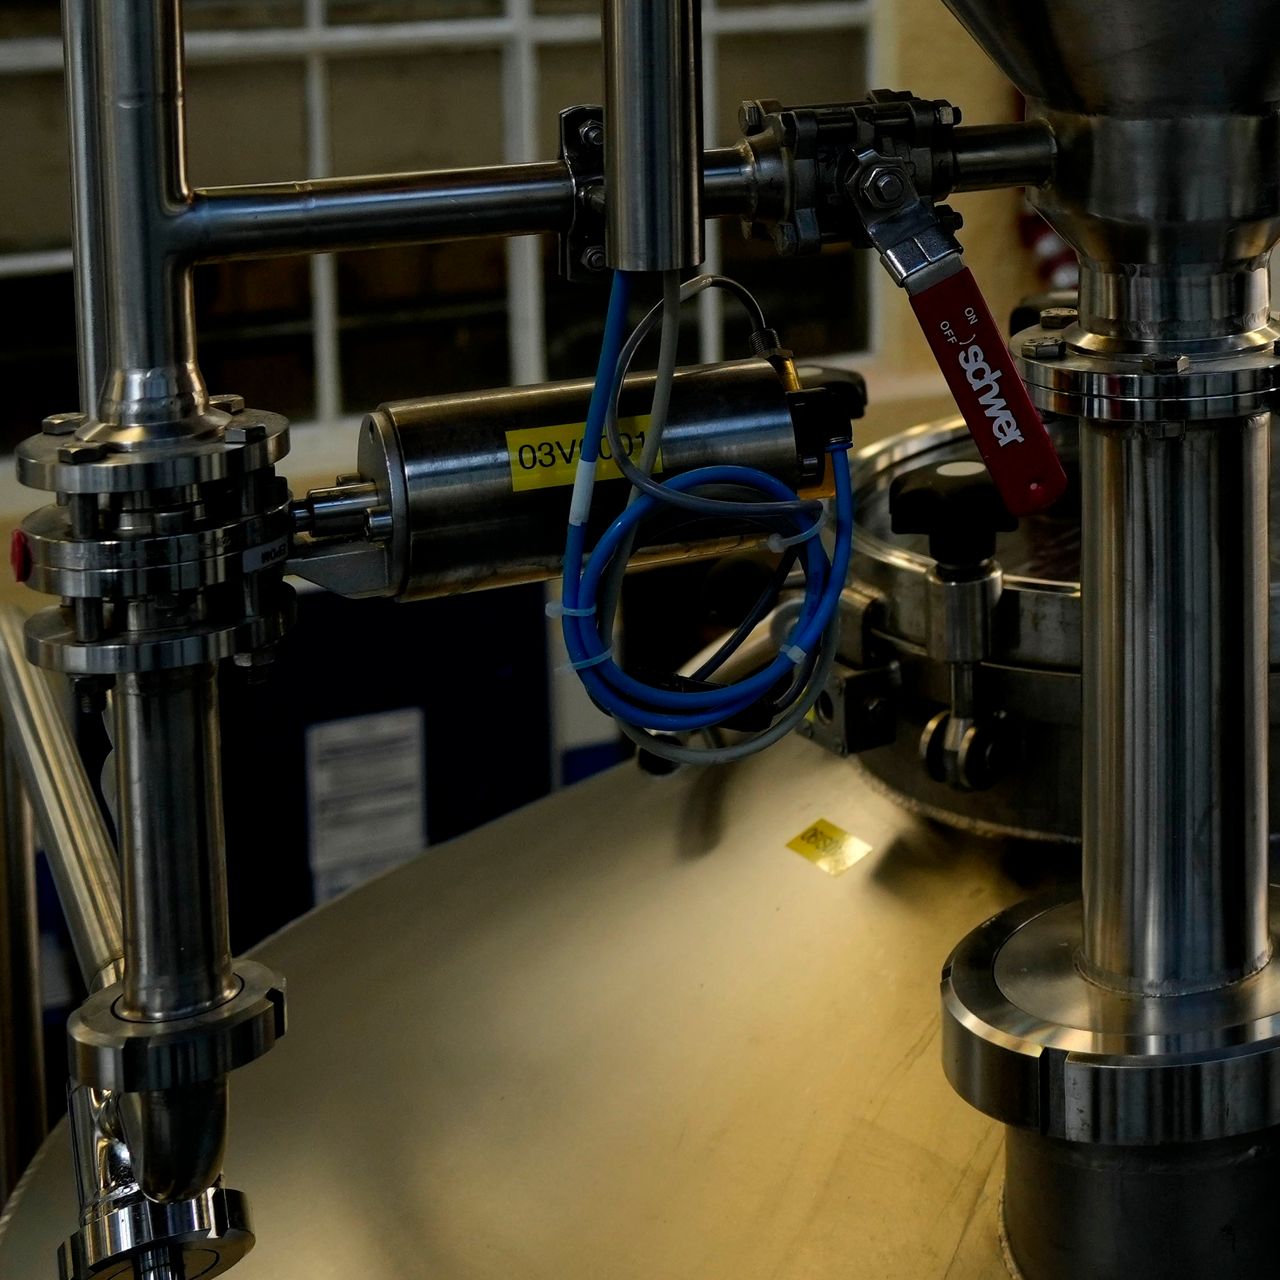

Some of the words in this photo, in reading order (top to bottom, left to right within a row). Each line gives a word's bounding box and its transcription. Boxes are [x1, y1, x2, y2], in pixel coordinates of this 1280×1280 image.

[964, 307, 978, 325] ON
[940, 320, 957, 344] OFF
[958, 344, 1025, 447] schwer
